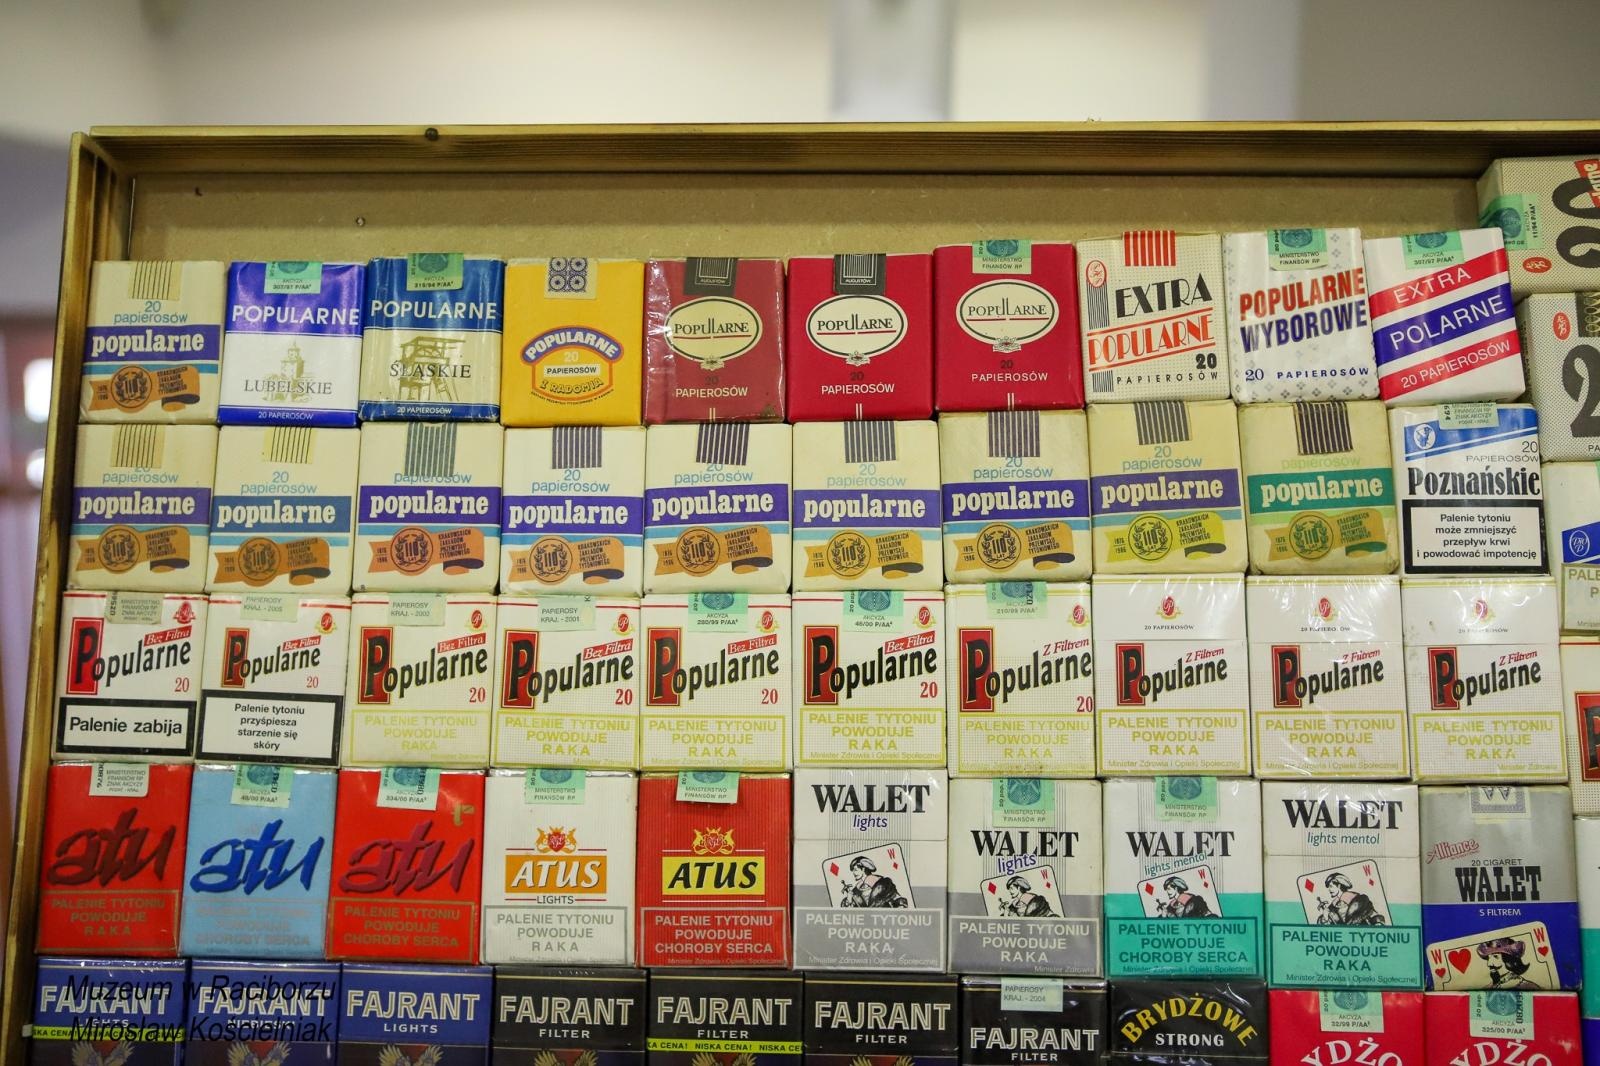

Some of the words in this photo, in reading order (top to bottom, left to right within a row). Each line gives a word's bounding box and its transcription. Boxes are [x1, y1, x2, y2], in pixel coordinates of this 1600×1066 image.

[1239, 268, 1365, 321] POPULARNE
[1394, 268, 1472, 304] EXTRA
[1115, 273, 1212, 318] EXTRA
[145, 301, 161, 312] 20
[232, 305, 359, 325] POPULARNE
[371, 301, 496, 320] POPULARNE
[968, 298, 1046, 317] POPULARNE
[675, 318, 748, 335] POPULARNE
[817, 314, 893, 331] POPULARNE
[1240, 300, 1367, 353] WYBOROWE
[1390, 295, 1506, 350] POLARNE
[92, 330, 204, 357] popularne
[525, 333, 619, 360] POPULARNE
[1089, 314, 1215, 365] POPULARNE
[1196, 353, 1217, 369] 20
[1400, 375, 1417, 389] 20
[1420, 340, 1511, 381] PAPIEROSÓW
[389, 361, 471, 379] ŚLĄSKIE
[972, 371, 1048, 382] PAPIEROSÓW
[1245, 369, 1264, 381] 20
[1277, 367, 1369, 379] PAPIEROSÓW
[244, 379, 332, 394] LUBELSKIE
[540, 380, 547, 389] Z
[549, 379, 604, 395] RADOMIA
[676, 386, 748, 398] PAPIEROSÓW
[822, 384, 895, 394] PAPIEROSÓW
[258, 411, 267, 419] 20
[269, 411, 314, 420] PAPIEROSÓW
[397, 406, 406, 414] 20
[407, 406, 452, 414] PAPIEROSÓW
[1522, 441, 1538, 452] 20
[1408, 466, 1540, 495] Poznańskie
[952, 485, 1074, 516] popularne
[1101, 476, 1224, 508] popularne
[1261, 476, 1383, 508] popularne
[79, 491, 195, 519] popularne
[370, 490, 489, 518] popularne
[652, 490, 774, 521] popularne
[803, 494, 925, 522] popularne
[217, 500, 336, 527] popularne
[509, 500, 628, 528] popularne
[1440, 514, 1474, 522] Palenie
[1478, 514, 1511, 524] tytoniu
[1436, 526, 1455, 534] może
[1458, 525, 1517, 536] zmniejszyć
[1443, 537, 1486, 548] przepływ
[1490, 537, 1510, 546] krwi
[1417, 550, 1420, 558] i
[1423, 549, 1481, 559] powodować
[1484, 549, 1537, 560] impotencję
[147, 633, 162, 645] Bez
[165, 628, 191, 641] Filtra
[439, 641, 454, 653] Bez
[457, 636, 484, 649] Filtra
[730, 643, 746, 654] Bez
[749, 637, 775, 650] Filtra
[1043, 644, 1050, 656] Z
[1054, 639, 1089, 654] Filtrem
[75, 626, 191, 687] Popularne
[227, 634, 320, 683] Popularne
[1186, 653, 1193, 663] Z
[1195, 648, 1224, 660] Filtrem
[365, 636, 487, 699] Popularne
[510, 640, 633, 703] Popularne
[654, 636, 779, 700] Popularne
[812, 636, 937, 699] Popularne
[967, 640, 1092, 703] Popularne
[1123, 648, 1228, 702] Popularne
[175, 677, 190, 692] 20
[1279, 651, 1384, 704] Popularne
[1435, 652, 1542, 706] Popularne
[470, 687, 486, 703] 20
[615, 689, 633, 705] 20
[235, 704, 269, 714] Palenie
[272, 705, 305, 715] tytoniu
[69, 717, 128, 733] Palenie
[134, 719, 182, 737] zabija
[240, 716, 297, 728] przyśpiesza
[238, 729, 281, 738] starzenie
[284, 730, 297, 740] się
[253, 740, 280, 751] skóry
[811, 784, 930, 813] WALET
[853, 814, 888, 831] lights
[1282, 799, 1403, 829] WALET
[49, 808, 177, 887] atu
[971, 830, 1079, 858] WALET
[1125, 831, 1235, 857] WALET
[1307, 832, 1336, 846] lights
[1340, 833, 1380, 844] mentol
[189, 819, 325, 895] atu
[339, 820, 474, 896] atu
[1144, 861, 1170, 876] lights
[1174, 852, 1208, 868] mentol
[1483, 858, 1522, 866] CIGARET
[510, 860, 601, 889] ATUS
[668, 862, 759, 889] ATUS
[1455, 866, 1541, 902] WALET
[536, 895, 574, 904] LIGHTS
[656, 916, 711, 926] PALENIE
[715, 916, 773, 926] TYTONIU
[1487, 908, 1521, 917] FILTREM
[675, 929, 752, 940] POWODUJE
[959, 922, 1021, 934] PALENIE
[1028, 924, 1090, 936] TYTONIU
[1119, 924, 1180, 935] PALENIE
[1184, 924, 1247, 934] TYTONIU
[1534, 927, 1545, 943] W
[655, 943, 722, 954] CHOROBY
[727, 943, 773, 954] SERCA
[982, 937, 1067, 949] POWODUJE
[1142, 938, 1225, 949] POWODUJE
[1001, 951, 1049, 962] RAKA
[1431, 949, 1442, 964] W
[346, 990, 480, 1020] FAJRANT
[500, 996, 634, 1025] FAJRANT
[657, 997, 792, 1026] FAJRANT
[815, 1001, 950, 1031] FAJRANT
[1121, 992, 1258, 1047] BRYDŻOWE
[384, 1023, 438, 1034] LIGHTS
[539, 1028, 590, 1039] FILTER
[697, 1029, 749, 1039] FILTER
[660, 1042, 688, 1050] CENA!
[725, 1043, 752, 1051] CENA!
[759, 1044, 786, 1052] NISKA
[856, 1034, 907, 1044] FILTER
[970, 1027, 1099, 1050] FAJRANT
[1155, 1033, 1224, 1046] STRONG
[1011, 1053, 1058, 1061] FILTER
